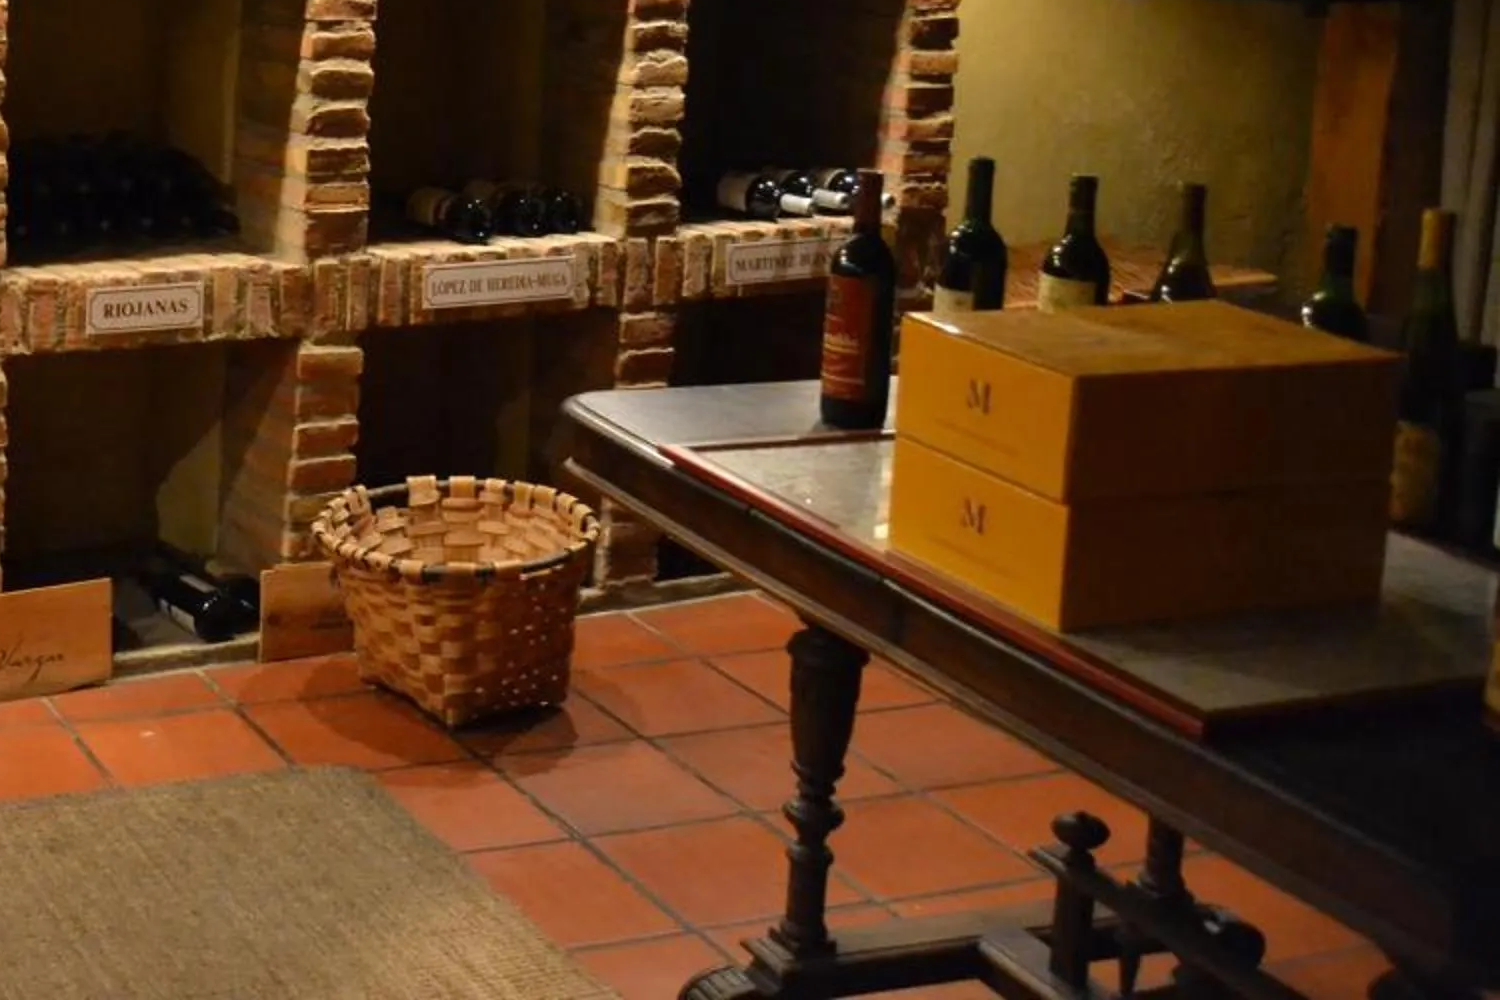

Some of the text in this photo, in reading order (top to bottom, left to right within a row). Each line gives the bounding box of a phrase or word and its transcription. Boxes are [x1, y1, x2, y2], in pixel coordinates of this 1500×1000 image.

[104, 299, 189, 319] RIOJANAS
[966, 379, 992, 415] M
[960, 497, 987, 536] M
